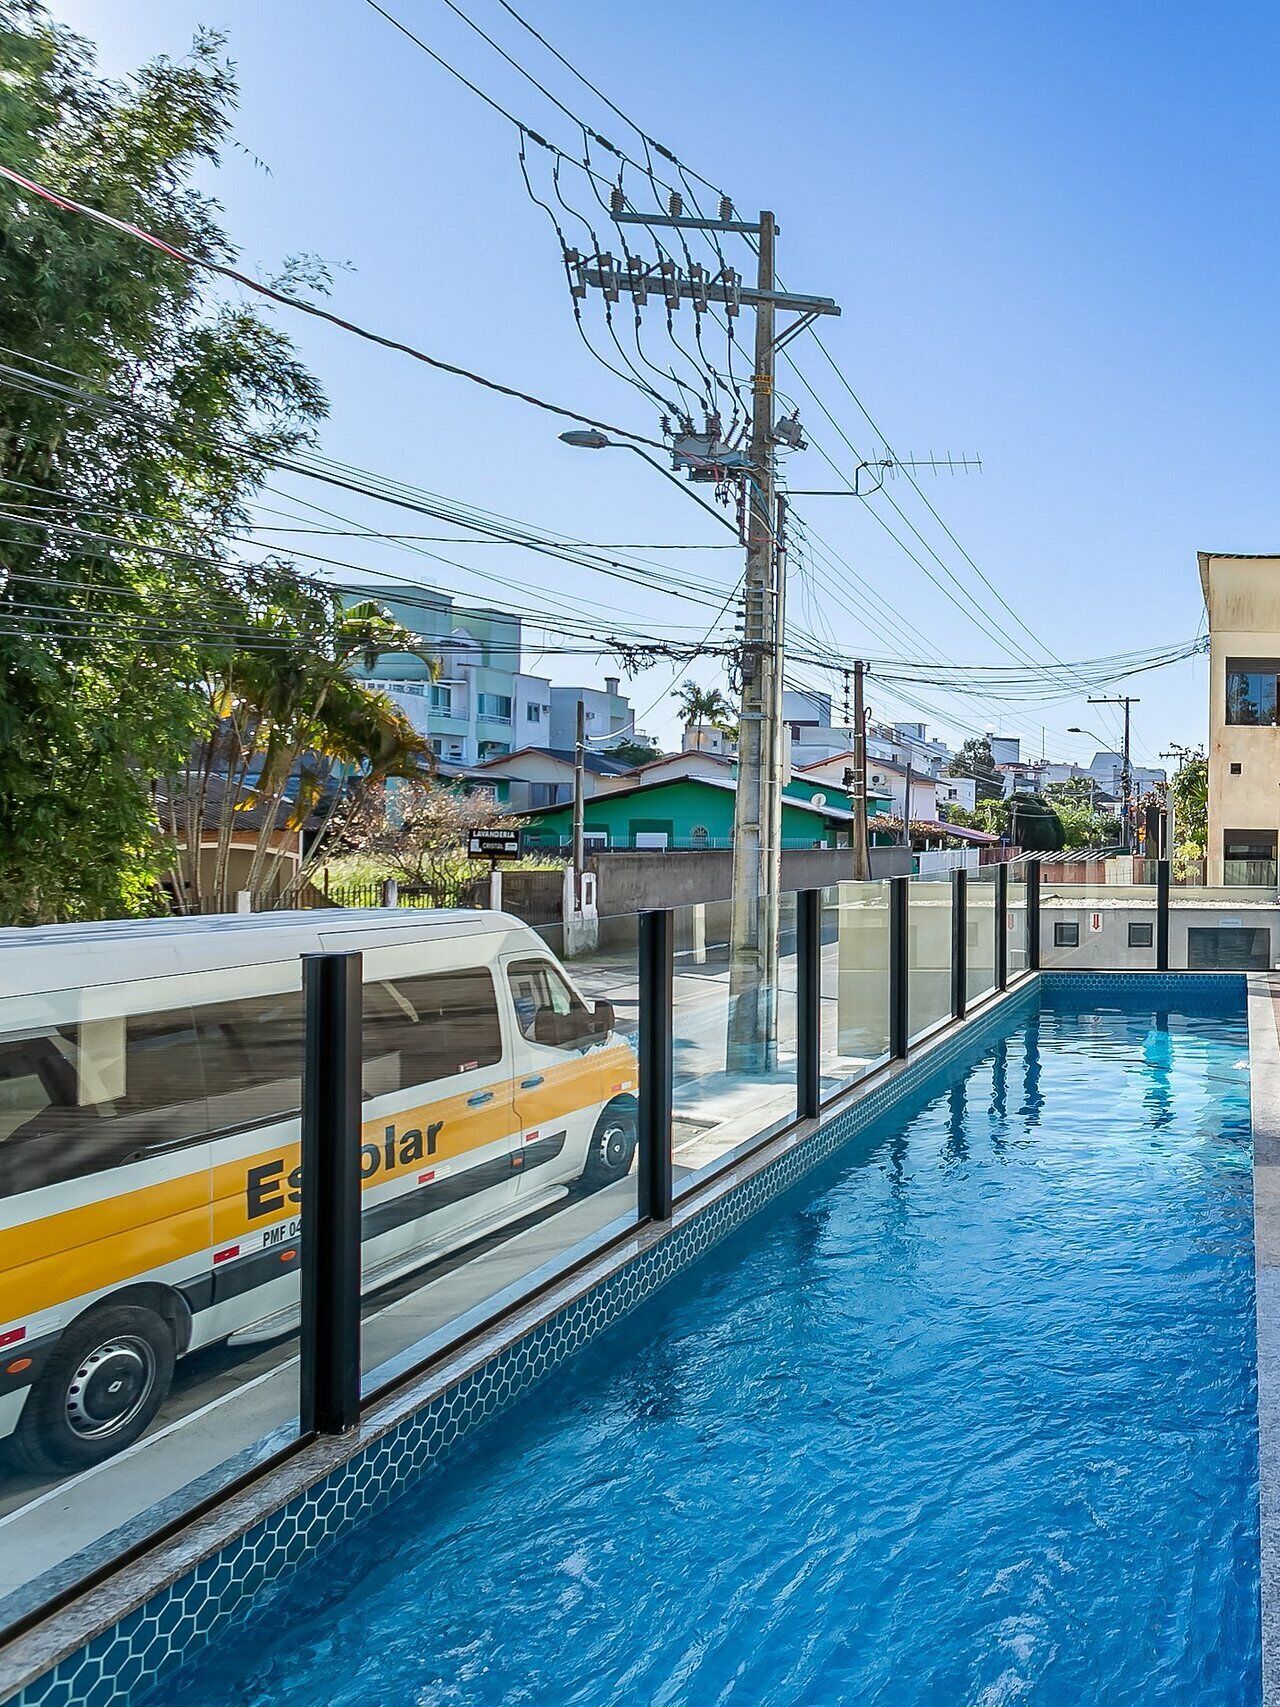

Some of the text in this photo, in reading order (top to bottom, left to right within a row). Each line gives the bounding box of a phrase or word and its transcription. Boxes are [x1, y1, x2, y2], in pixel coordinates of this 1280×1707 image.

[473, 830, 515, 838] LAVANDERIA
[247, 1120, 444, 1220] Esolar
[263, 1225, 287, 1247] PMF
